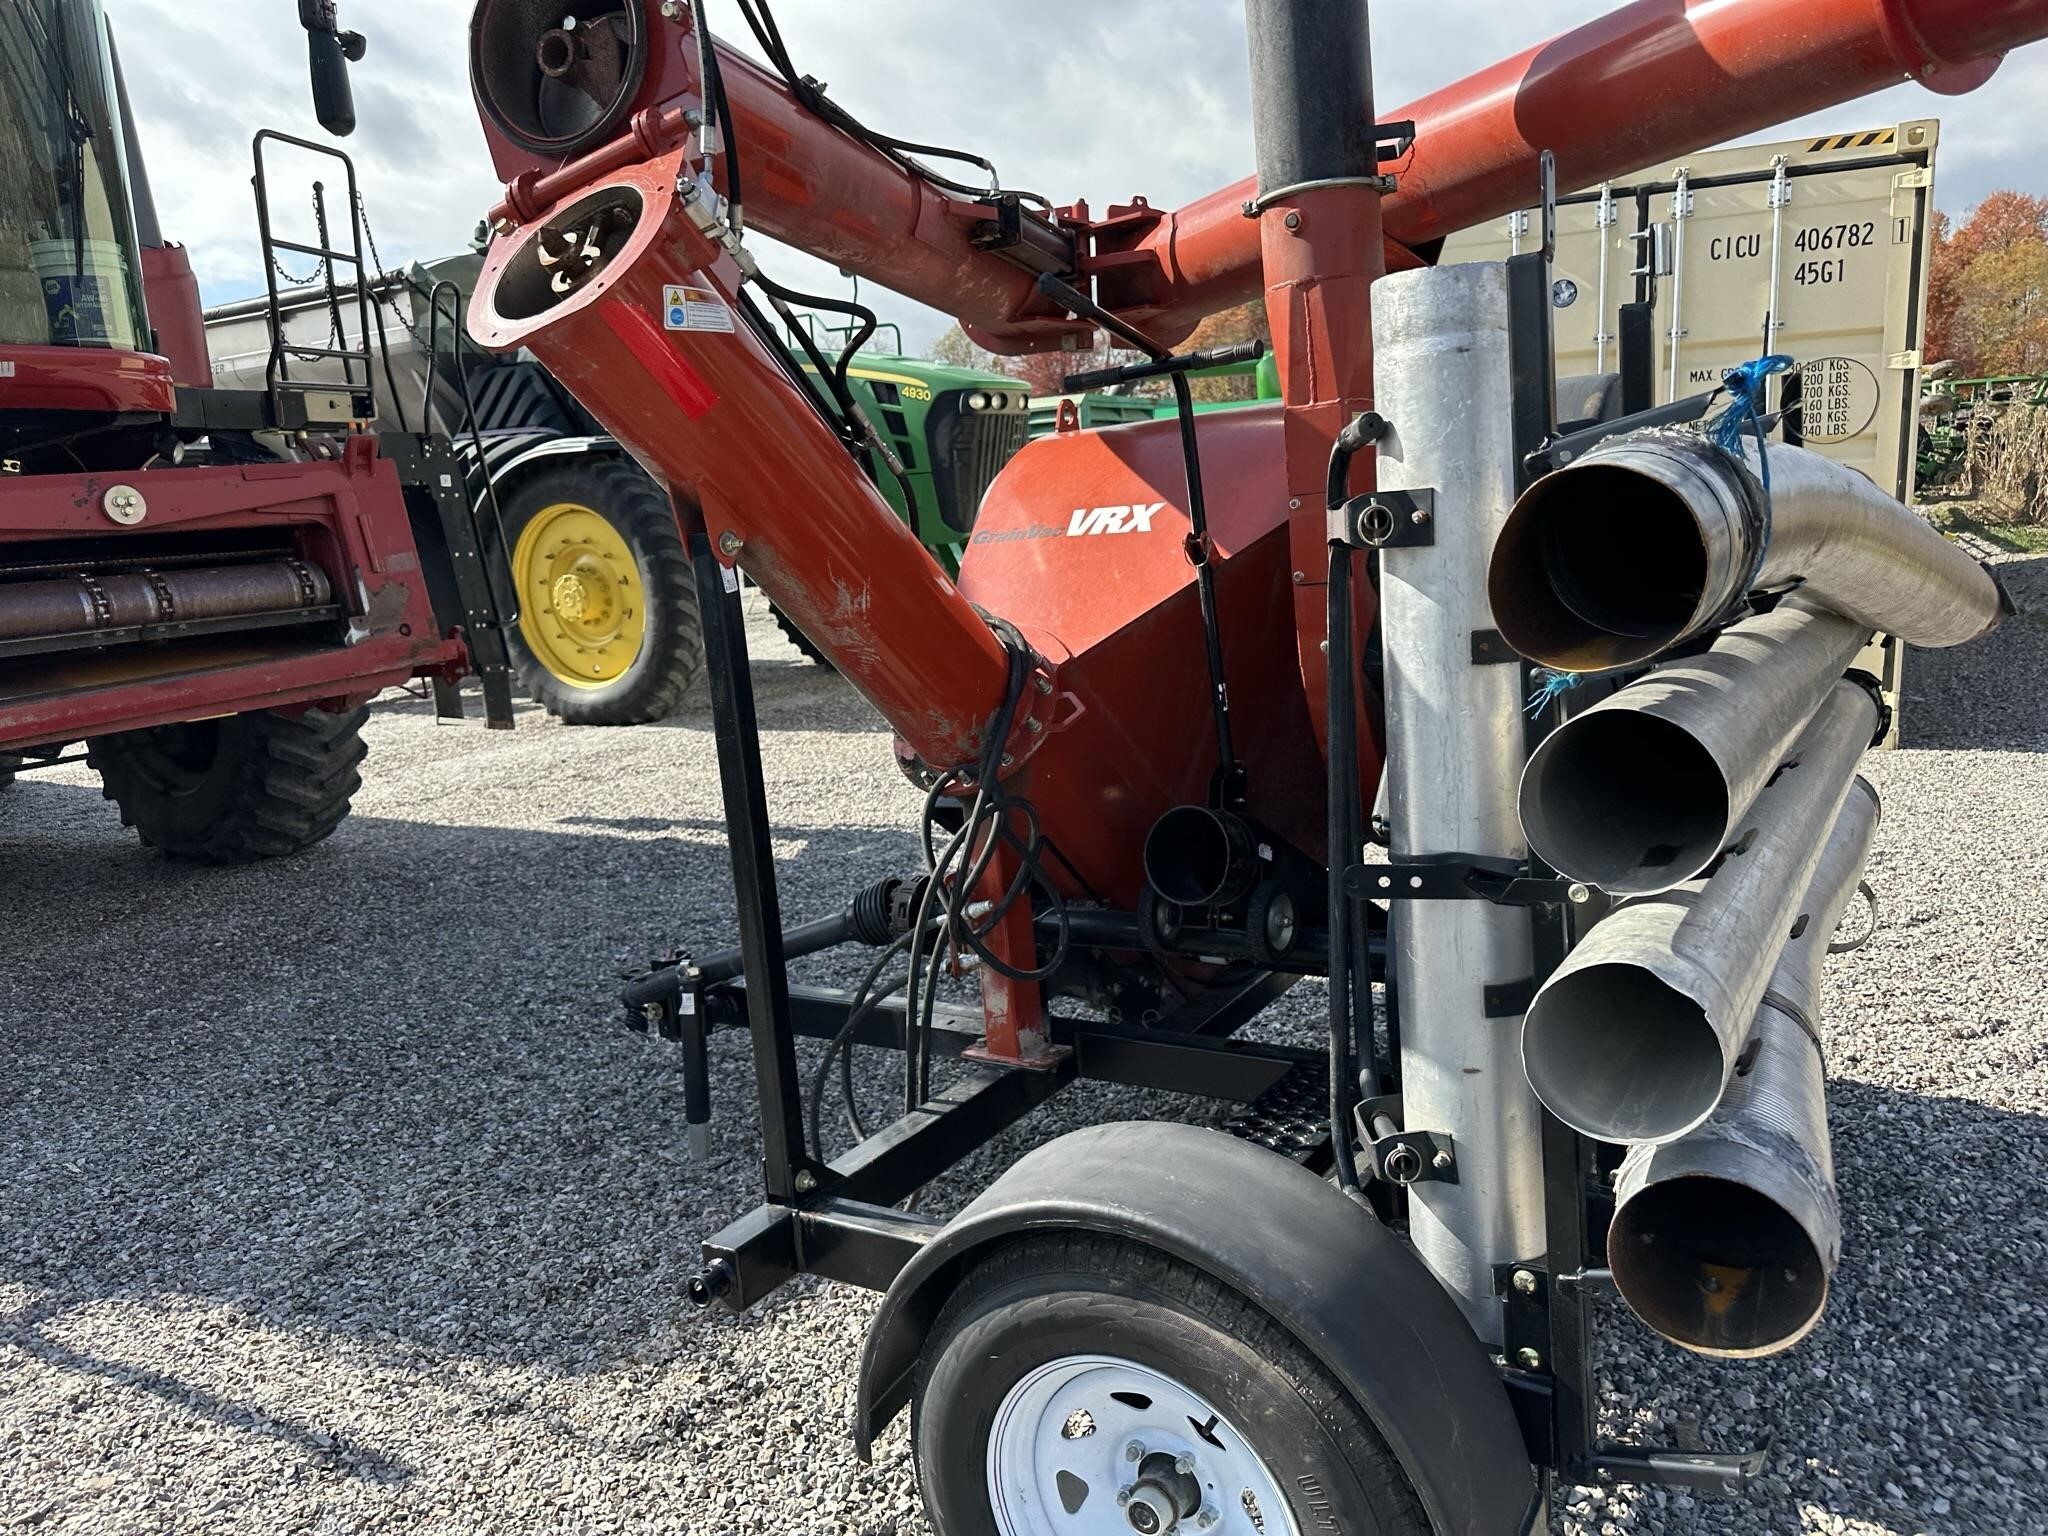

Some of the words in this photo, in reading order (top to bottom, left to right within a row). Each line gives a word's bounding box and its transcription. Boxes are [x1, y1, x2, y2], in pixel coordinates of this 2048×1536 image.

[1710, 234, 1761, 261] CICU
[1794, 222, 1874, 252] 406782
[1898, 218, 1905, 242] 1
[1794, 259, 1844, 286] 45G1
[1689, 369, 1717, 383] MAX.
[1803, 373, 1824, 386] 200
[1829, 371, 1851, 384] LBS.
[901, 386, 931, 402] 4930
[1803, 386, 1823, 399] 700
[1828, 384, 1851, 397] KGS.
[1828, 397, 1850, 410] LBS.
[1803, 412, 1822, 425] 780
[1827, 410, 1850, 423] KGS.
[1827, 423, 1849, 435] LBS.
[973, 524, 1065, 545] GrainVac
[1066, 502, 1168, 537] VRX
[1297, 1473, 1342, 1536] ULT
